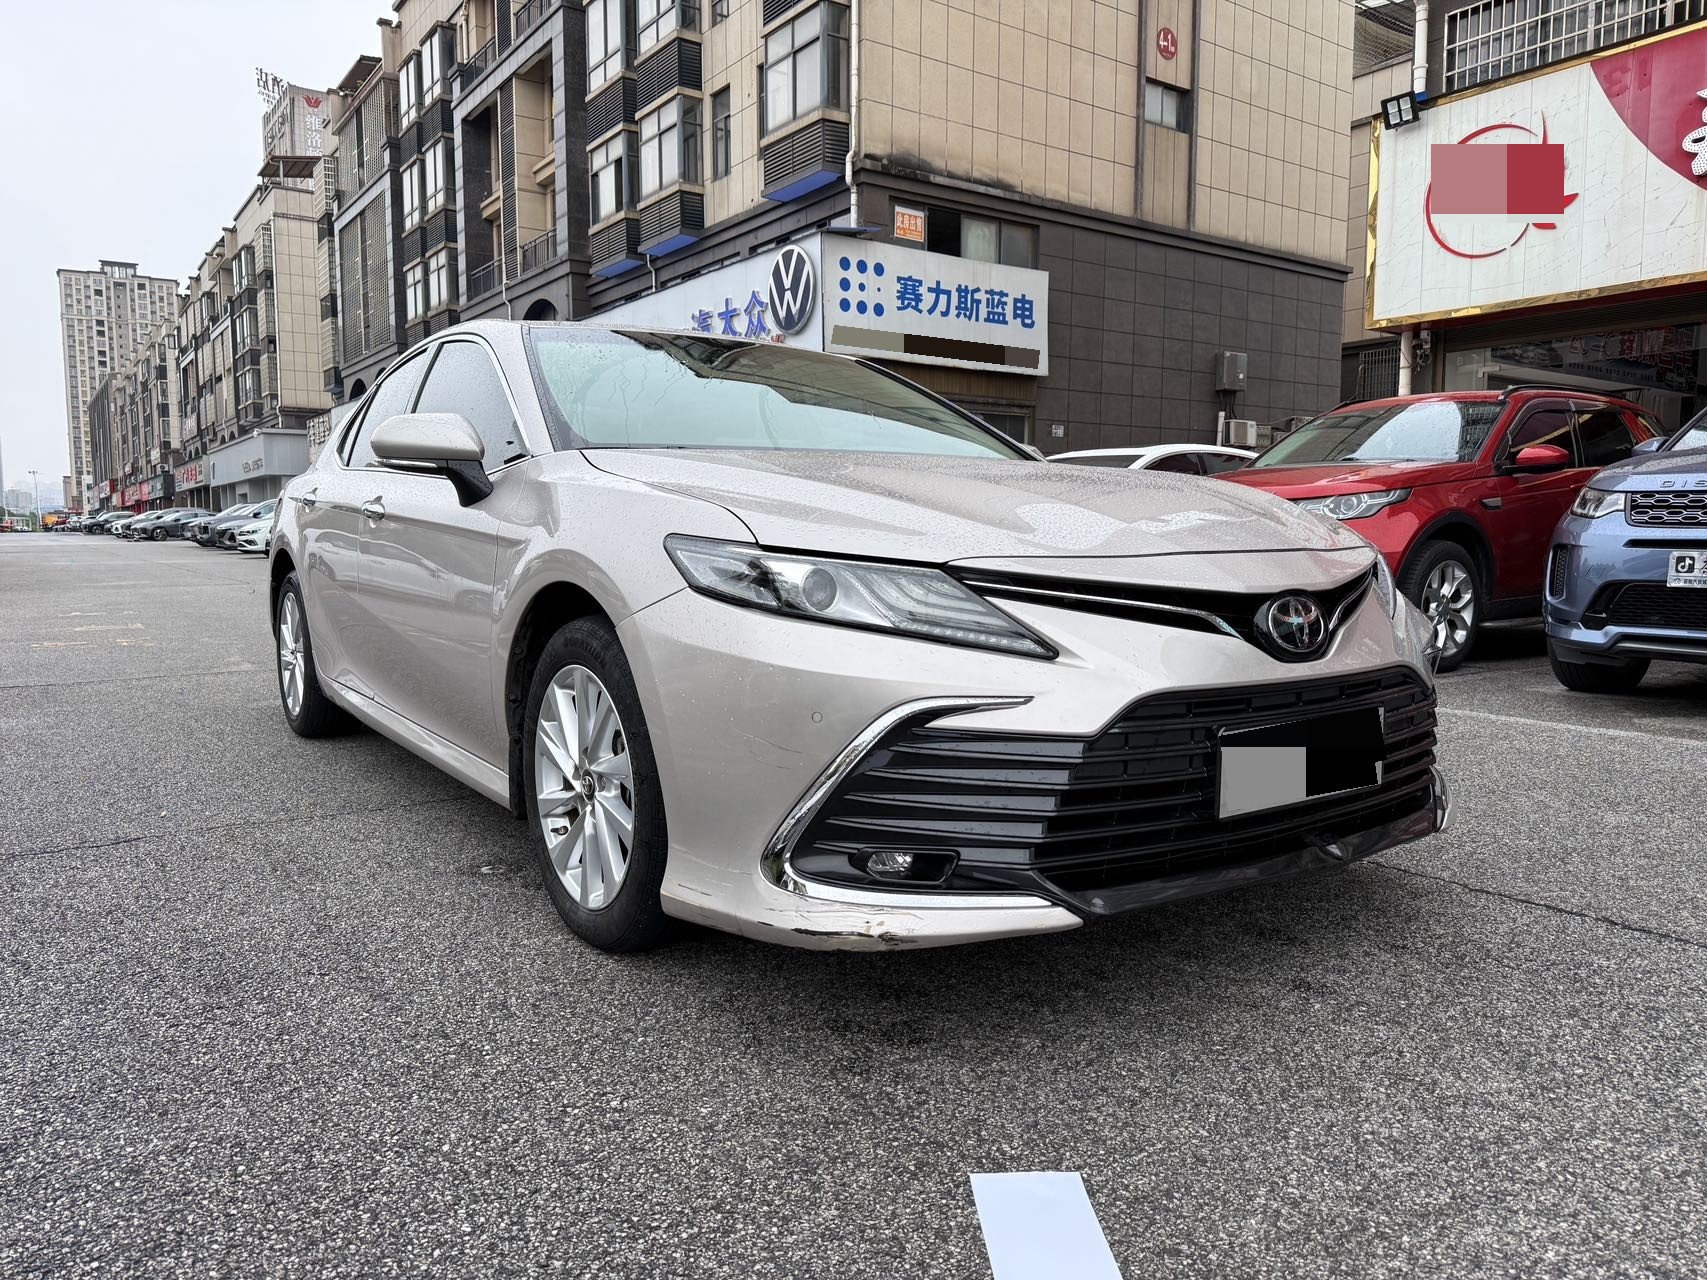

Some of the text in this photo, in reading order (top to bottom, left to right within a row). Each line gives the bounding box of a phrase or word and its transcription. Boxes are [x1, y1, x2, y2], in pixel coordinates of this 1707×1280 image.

[896, 275, 1036, 329] 赛力斯蓝电
